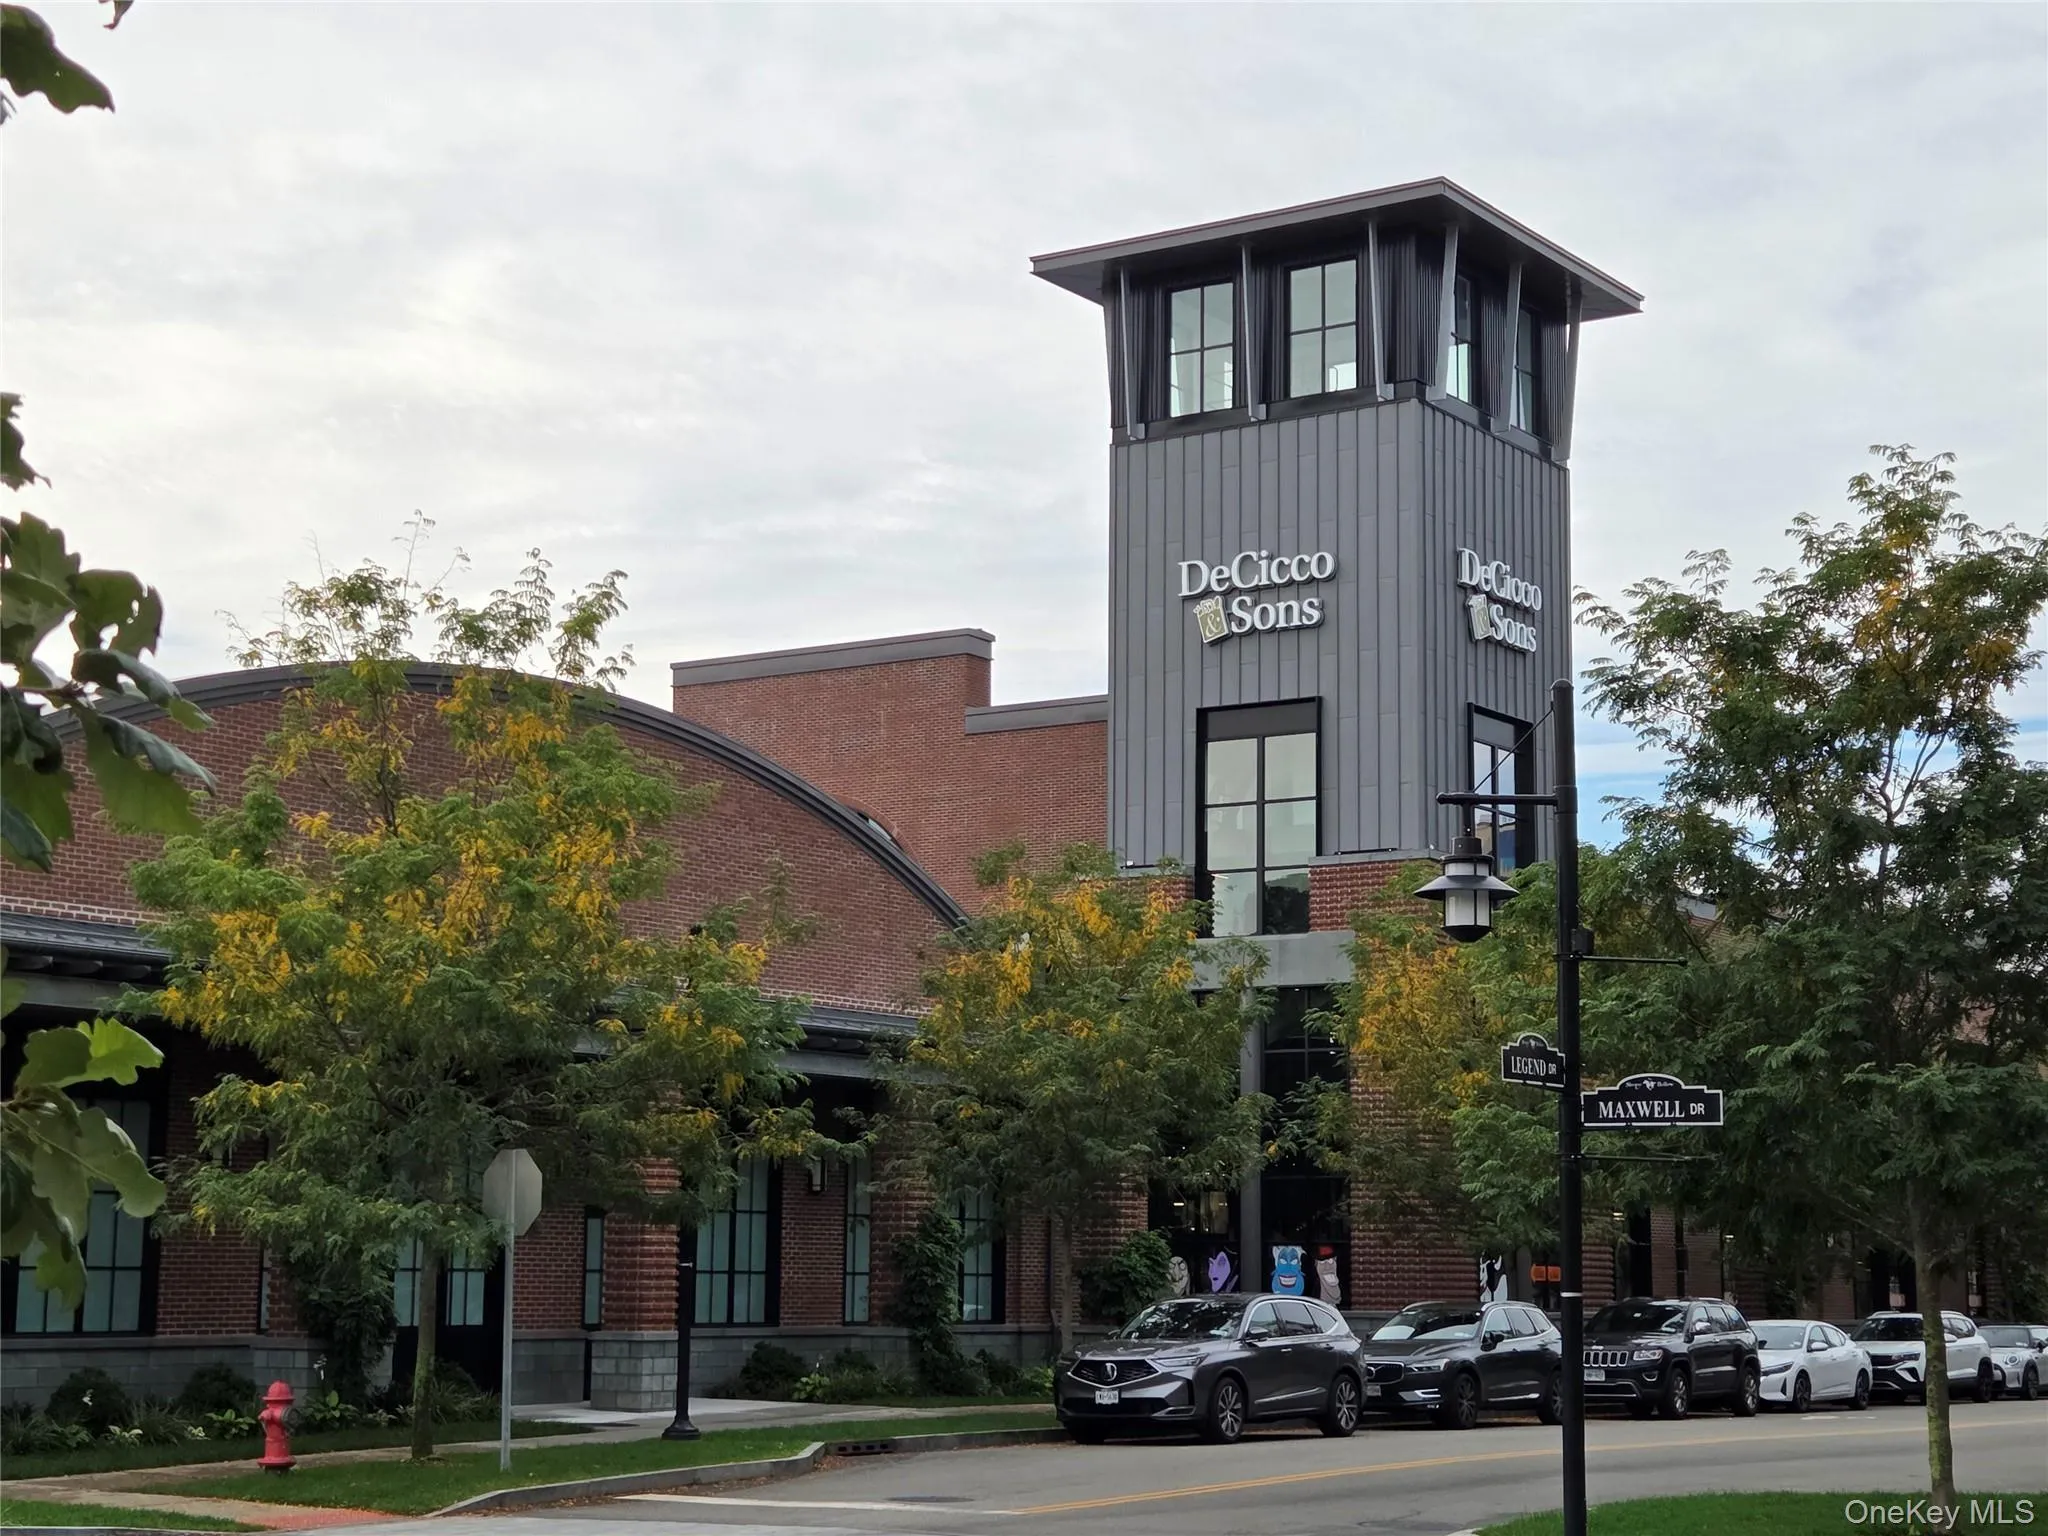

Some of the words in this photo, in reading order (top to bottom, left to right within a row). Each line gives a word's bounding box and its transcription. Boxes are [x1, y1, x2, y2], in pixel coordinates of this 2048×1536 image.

[1177, 550, 1337, 598] DeCicco
[1457, 545, 1542, 611] DeCicco
[1230, 595, 1322, 634] Sons
[1489, 603, 1537, 652] Sons
[1511, 1055, 1547, 1077] LEGEND
[1548, 1062, 1557, 1075] DR
[1598, 1100, 1685, 1119] MAXWELL
[1689, 1102, 1705, 1116] DR
